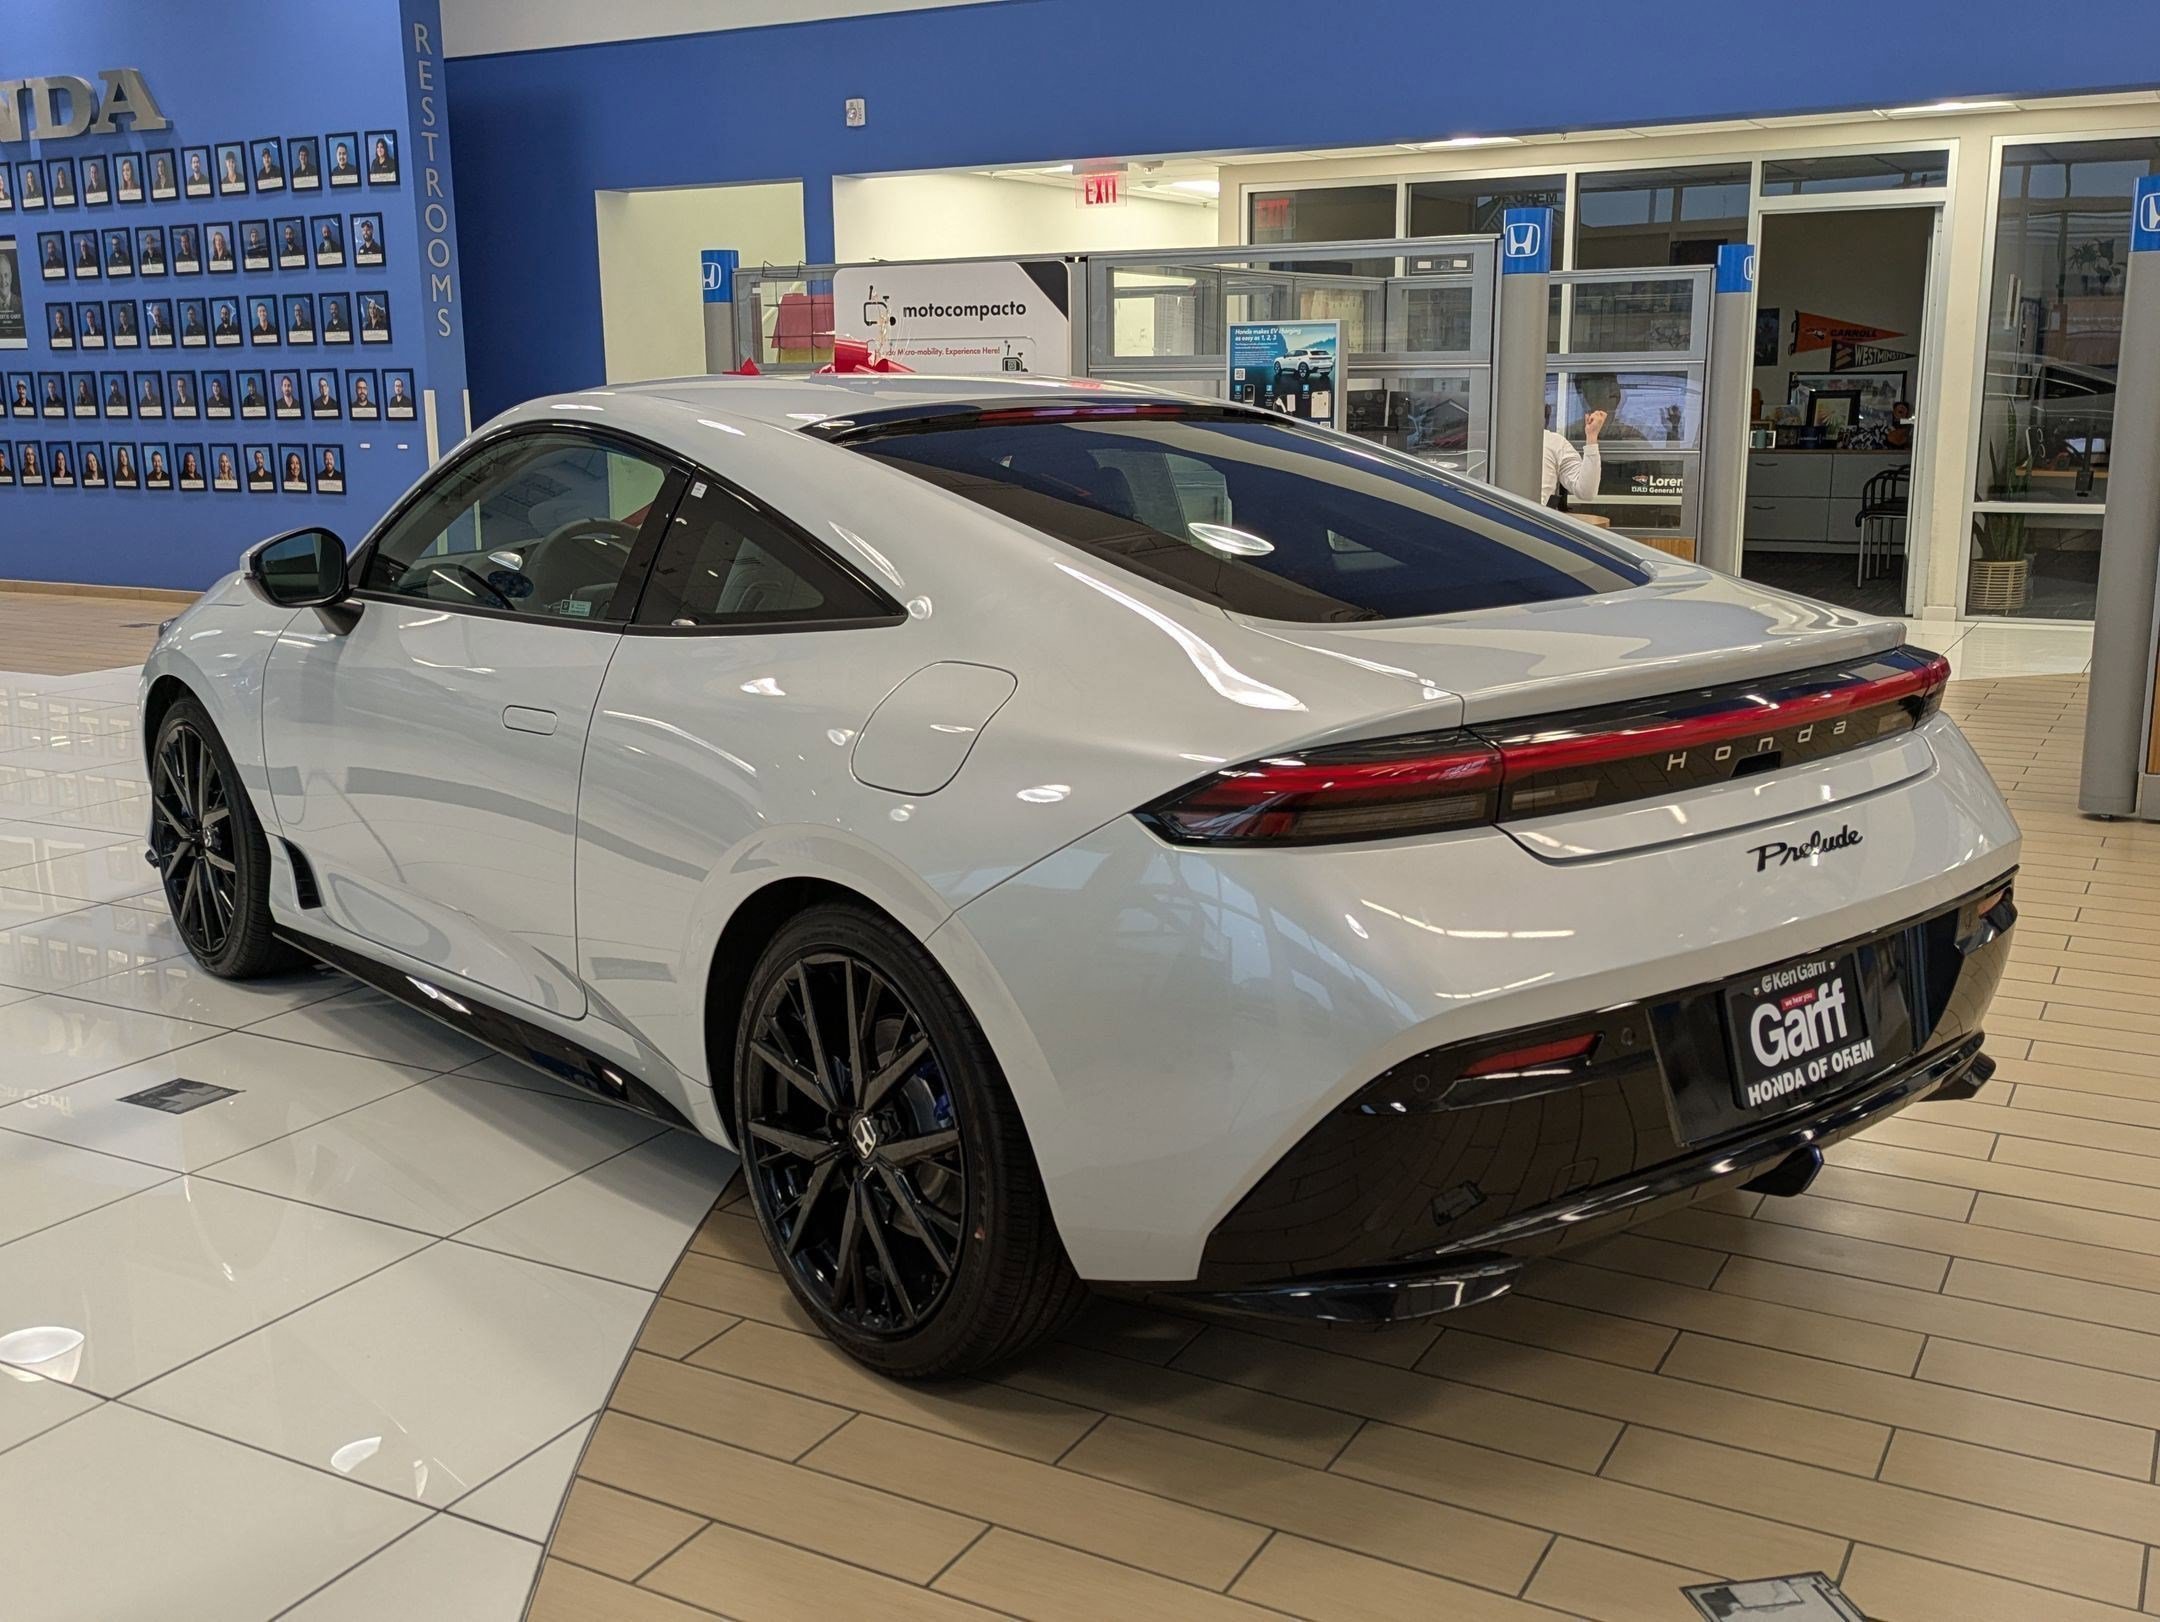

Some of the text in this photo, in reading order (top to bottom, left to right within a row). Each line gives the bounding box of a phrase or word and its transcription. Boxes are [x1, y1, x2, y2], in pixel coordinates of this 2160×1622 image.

[414, 23, 452, 337] RESTROOMS
[1085, 175, 1118, 205] EXIT
[903, 301, 1027, 321] motocompacto
[945, 347, 981, 357] Experience
[982, 346, 1001, 355] Here!
[1830, 328, 1878, 338] CARROLL
[1667, 721, 1847, 771] Honda
[1747, 824, 1864, 872] Prelude
[1772, 970, 1798, 990] Ken
[1750, 977, 1848, 1068] Garff
[1747, 1039, 1875, 1107] HONDA OF OREM
